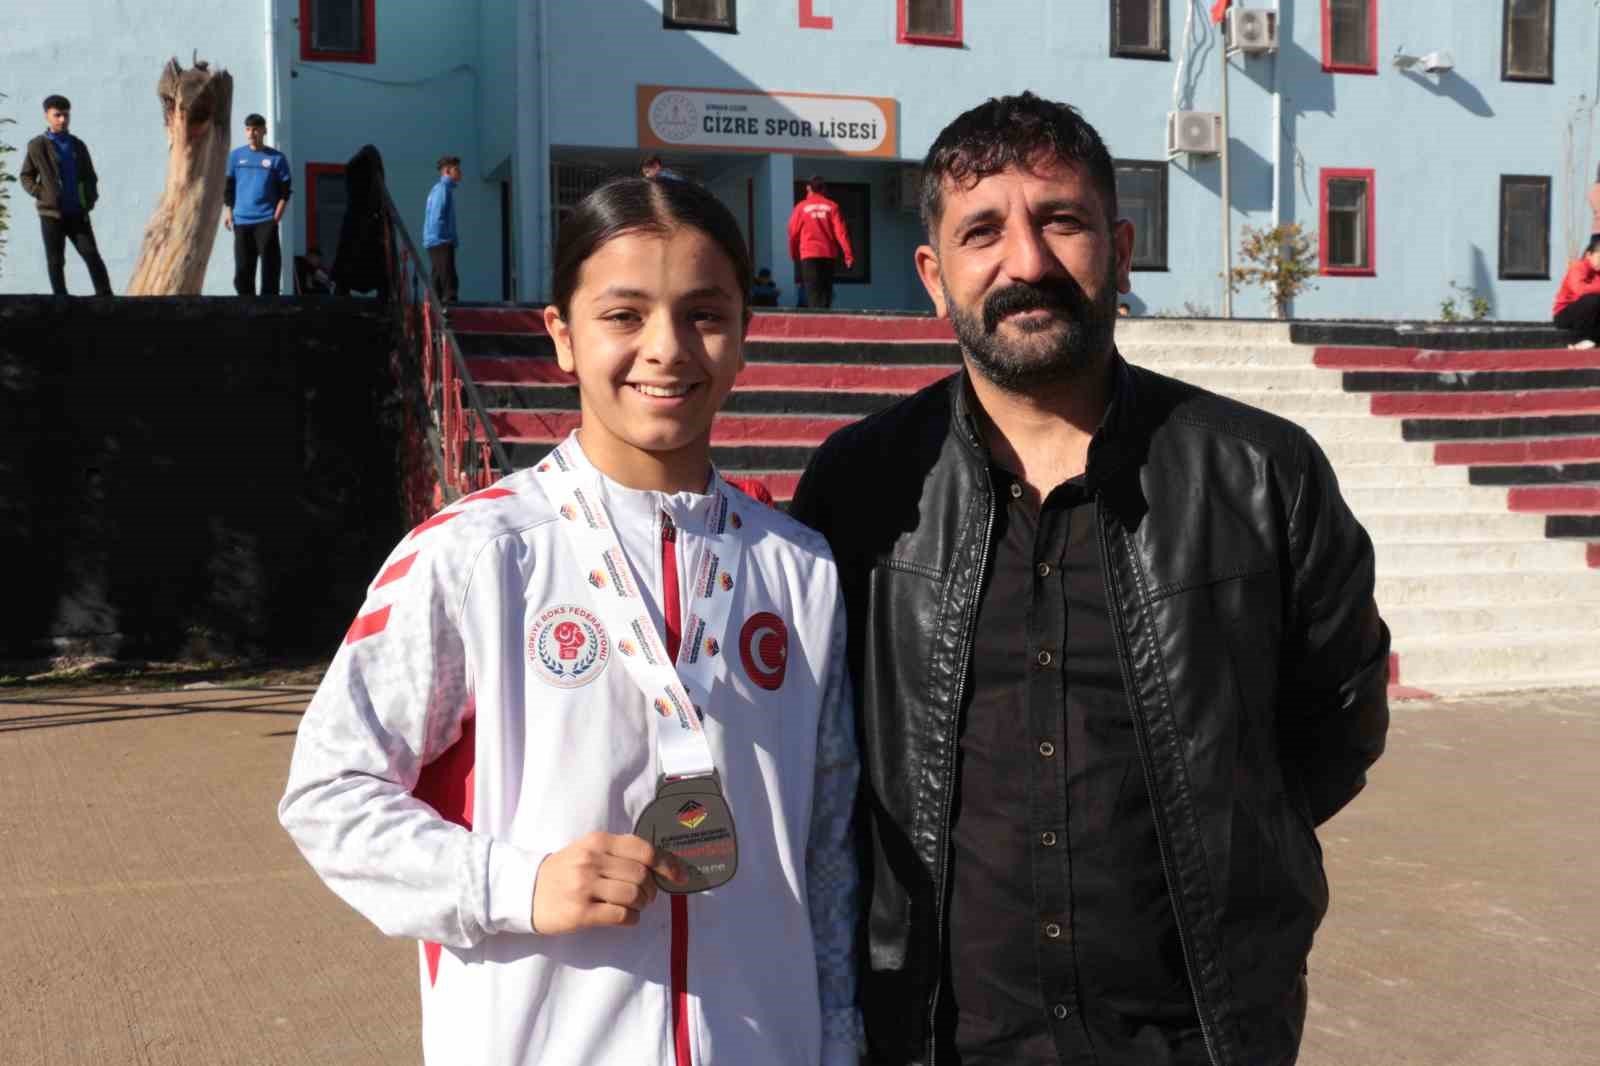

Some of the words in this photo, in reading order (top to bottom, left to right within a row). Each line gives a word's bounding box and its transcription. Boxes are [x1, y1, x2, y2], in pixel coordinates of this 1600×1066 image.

[703, 111, 759, 135] CİZRE
[765, 118, 812, 138] SPOR
[819, 117, 878, 140] LİSESİ
[541, 607, 566, 622] BOKS
[569, 607, 608, 662] FEDERASYONU
